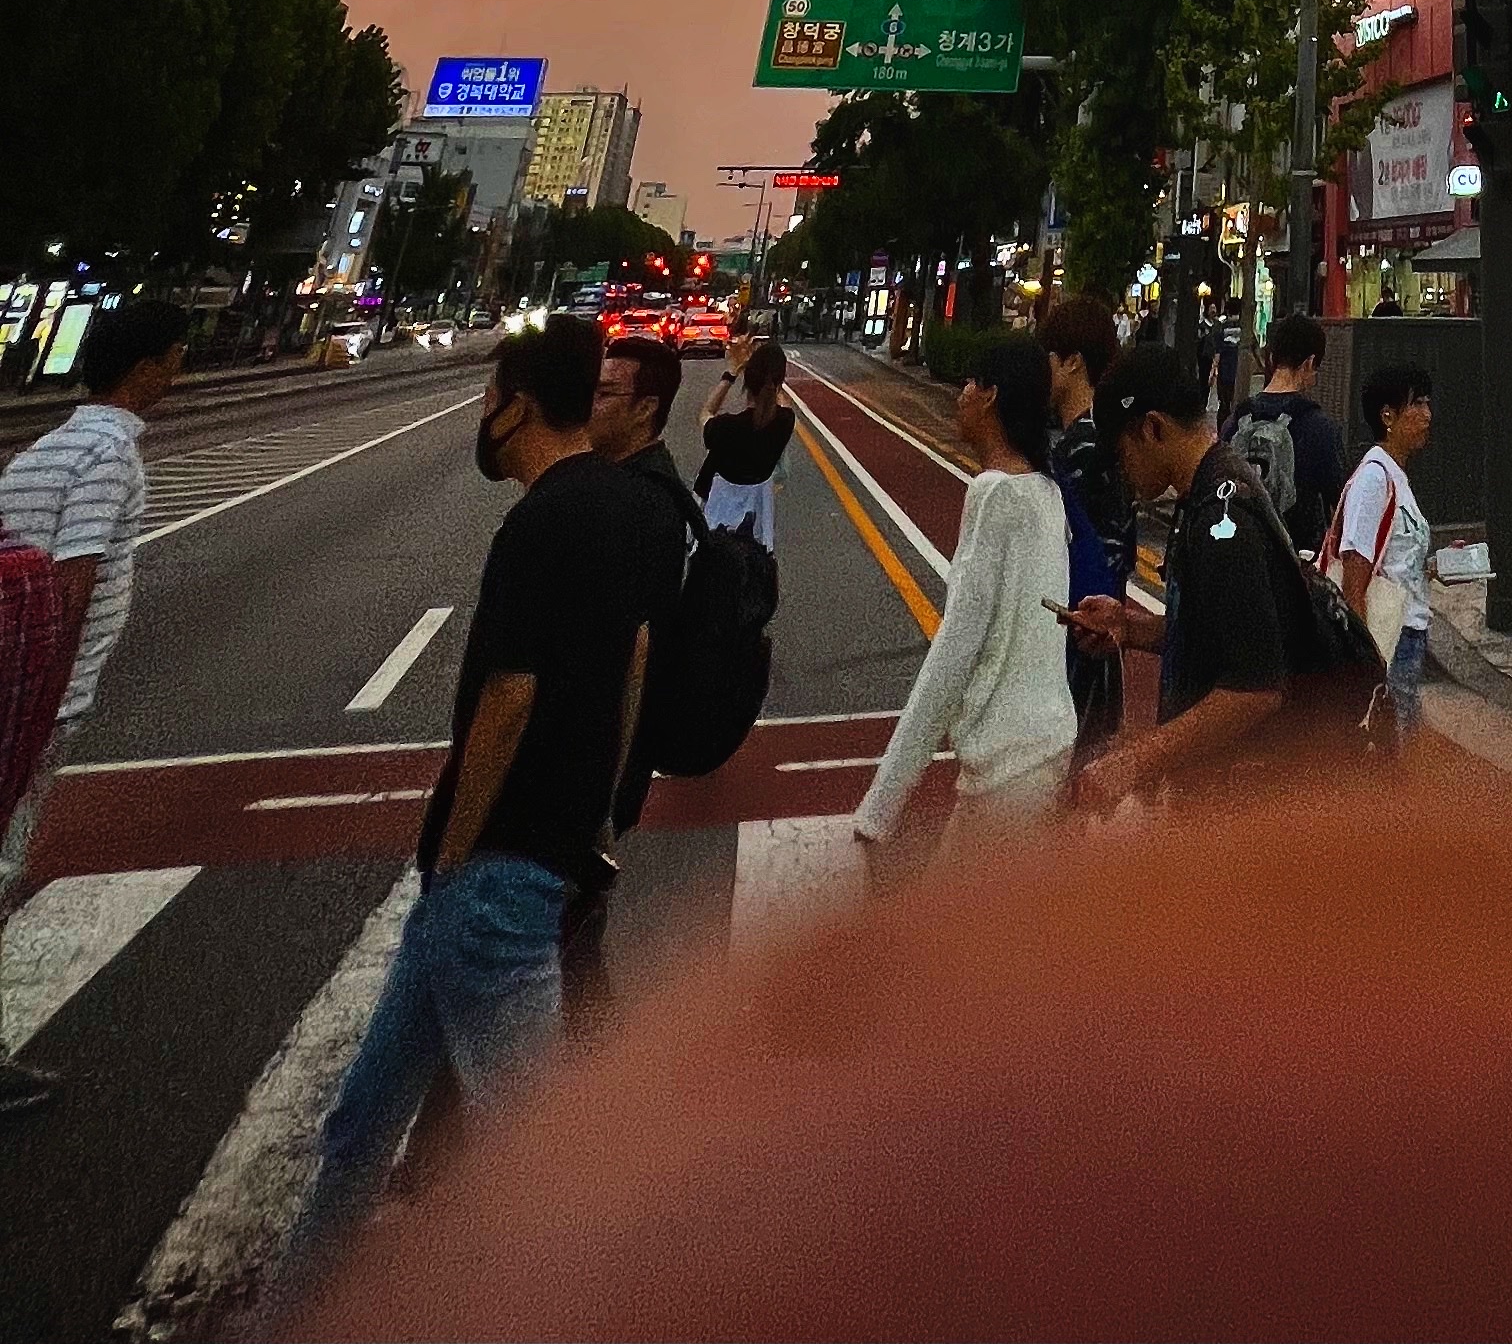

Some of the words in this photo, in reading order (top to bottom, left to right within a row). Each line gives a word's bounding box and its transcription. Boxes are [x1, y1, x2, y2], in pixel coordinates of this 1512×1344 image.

[787, 0, 806, 13] 50
[783, 21, 841, 40] 창덕궁
[889, 21, 898, 33] 6
[1457, 174, 1478, 186] CU
